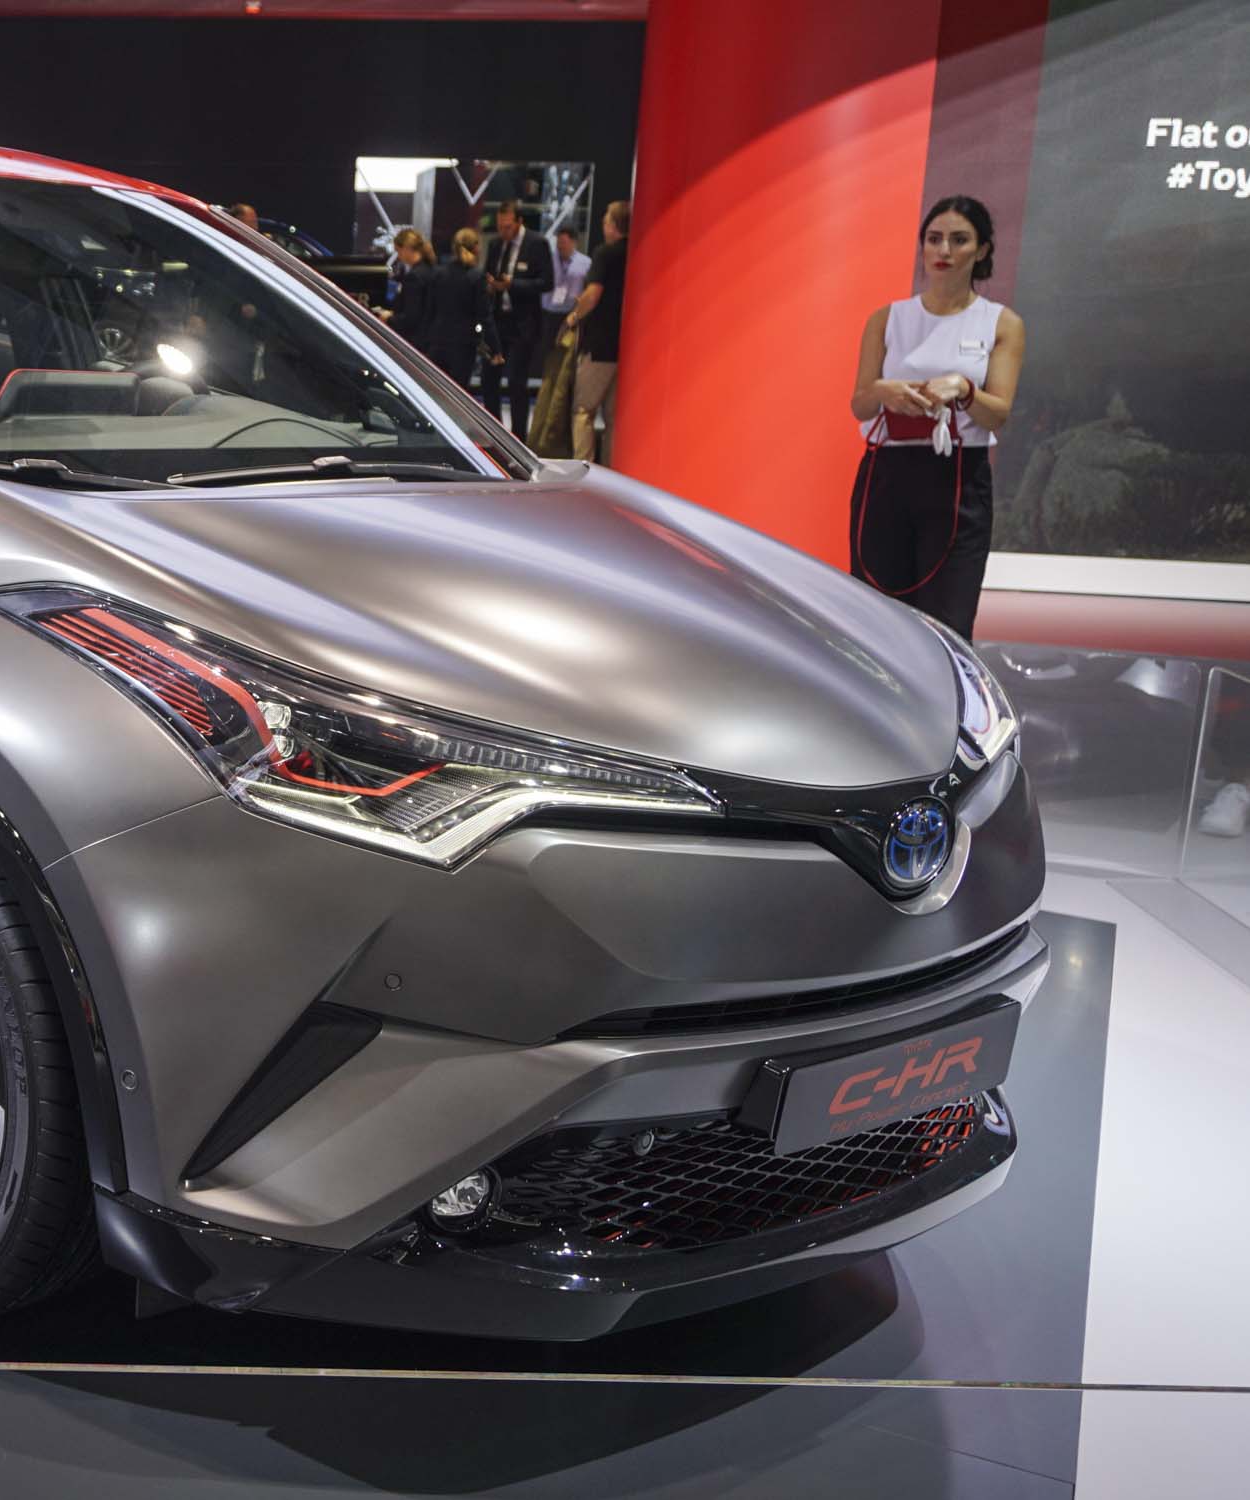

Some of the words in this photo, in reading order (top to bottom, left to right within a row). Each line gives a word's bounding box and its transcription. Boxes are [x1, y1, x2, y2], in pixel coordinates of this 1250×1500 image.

[1145, 117, 1219, 149] Flat
[1225, 124, 1250, 149] o
[828, 1036, 983, 1115] C-HR
